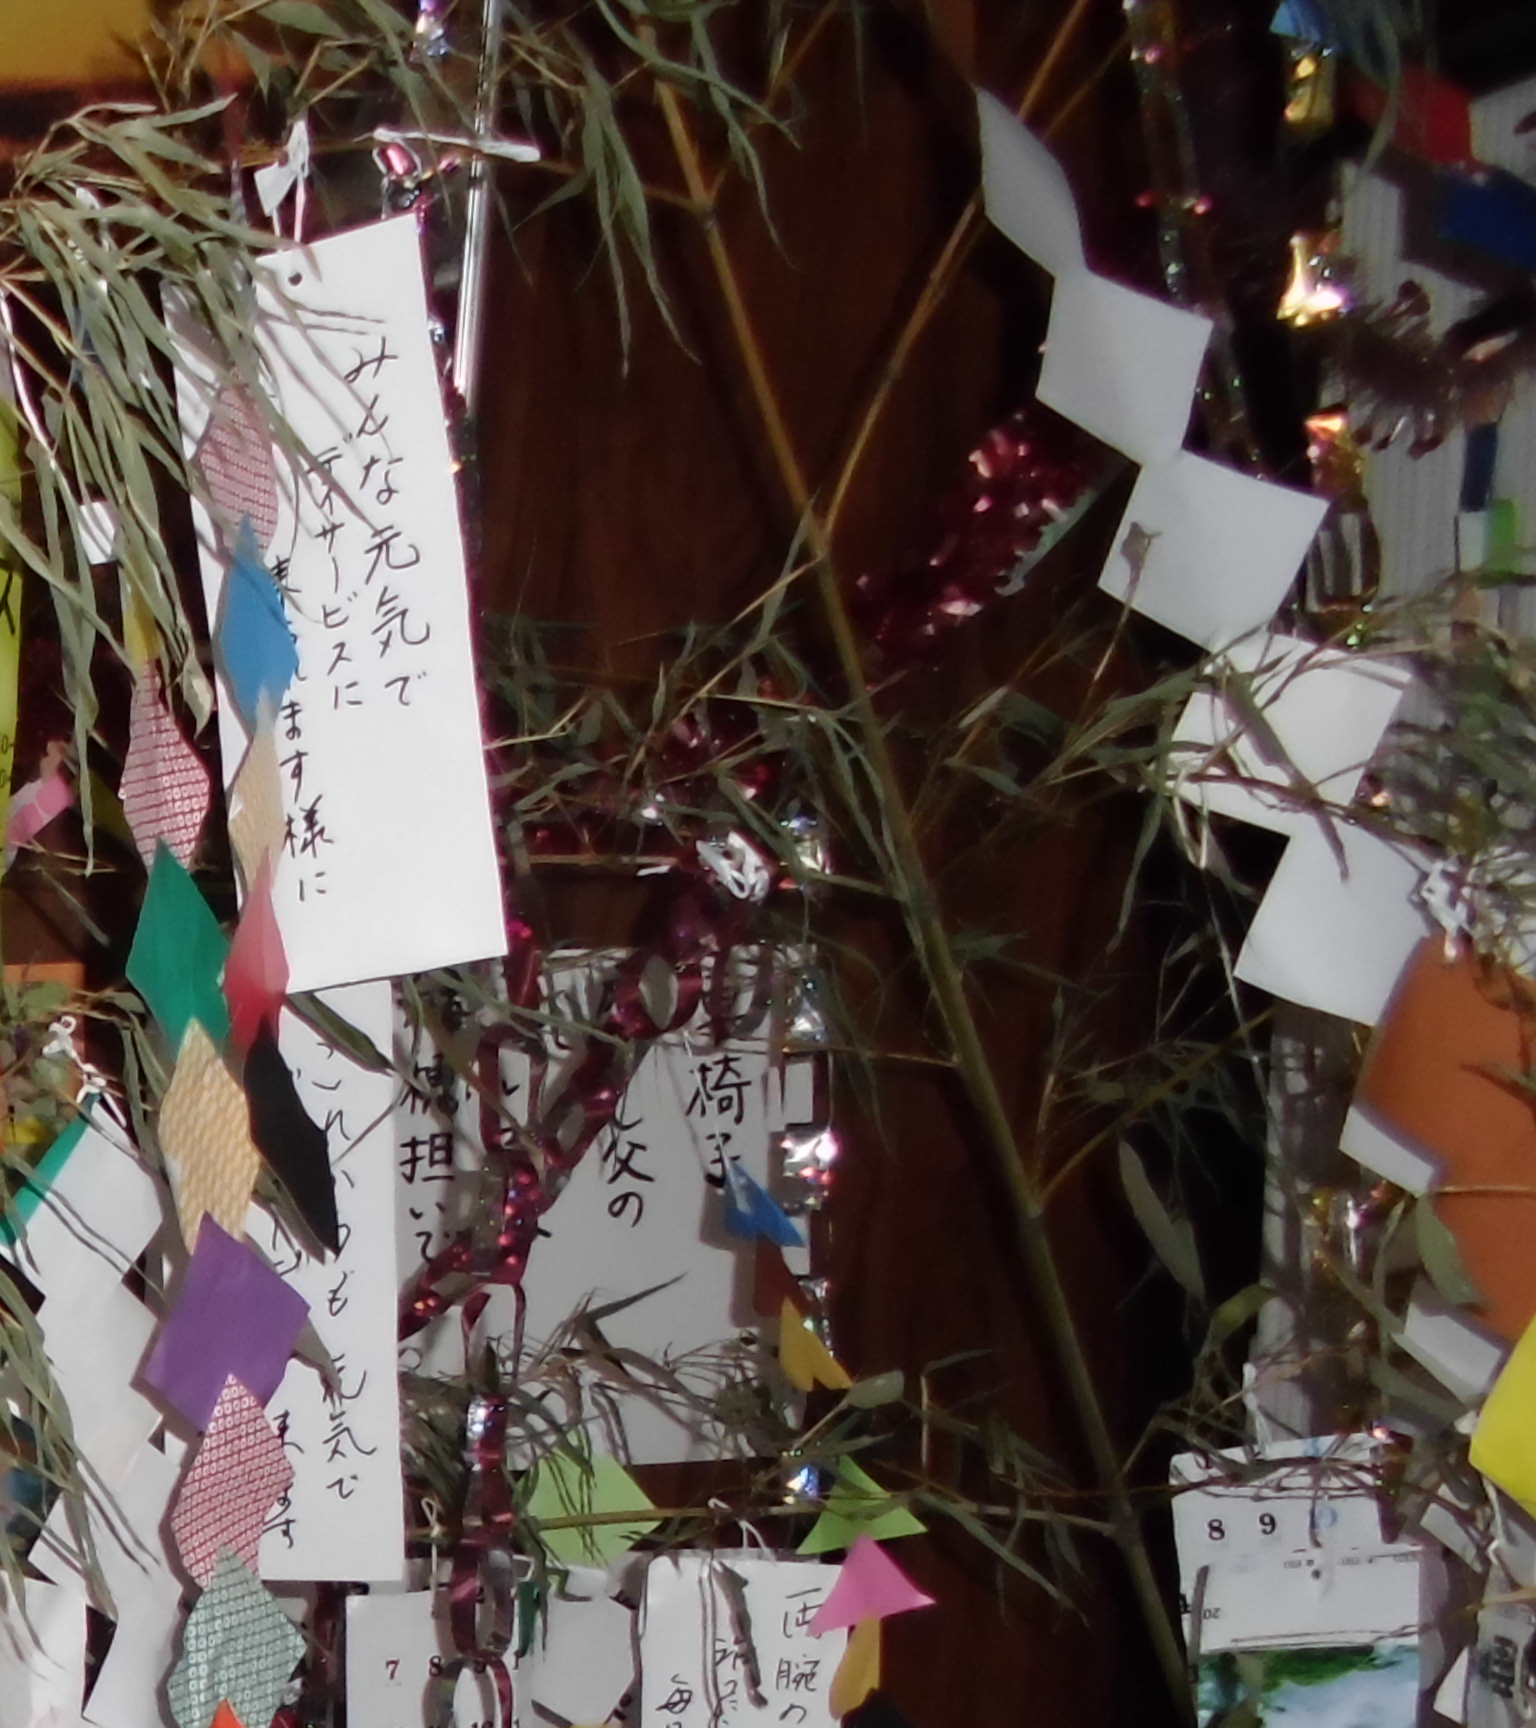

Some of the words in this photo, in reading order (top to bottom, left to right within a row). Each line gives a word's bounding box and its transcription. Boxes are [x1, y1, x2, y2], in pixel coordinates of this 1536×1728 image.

[343, 337, 431, 706] みんな元気で
[1207, 1518, 1226, 1541] 8
[1258, 1513, 1277, 1536] 9
[385, 1660, 400, 1680] 7
[428, 1656, 444, 1677] 8
